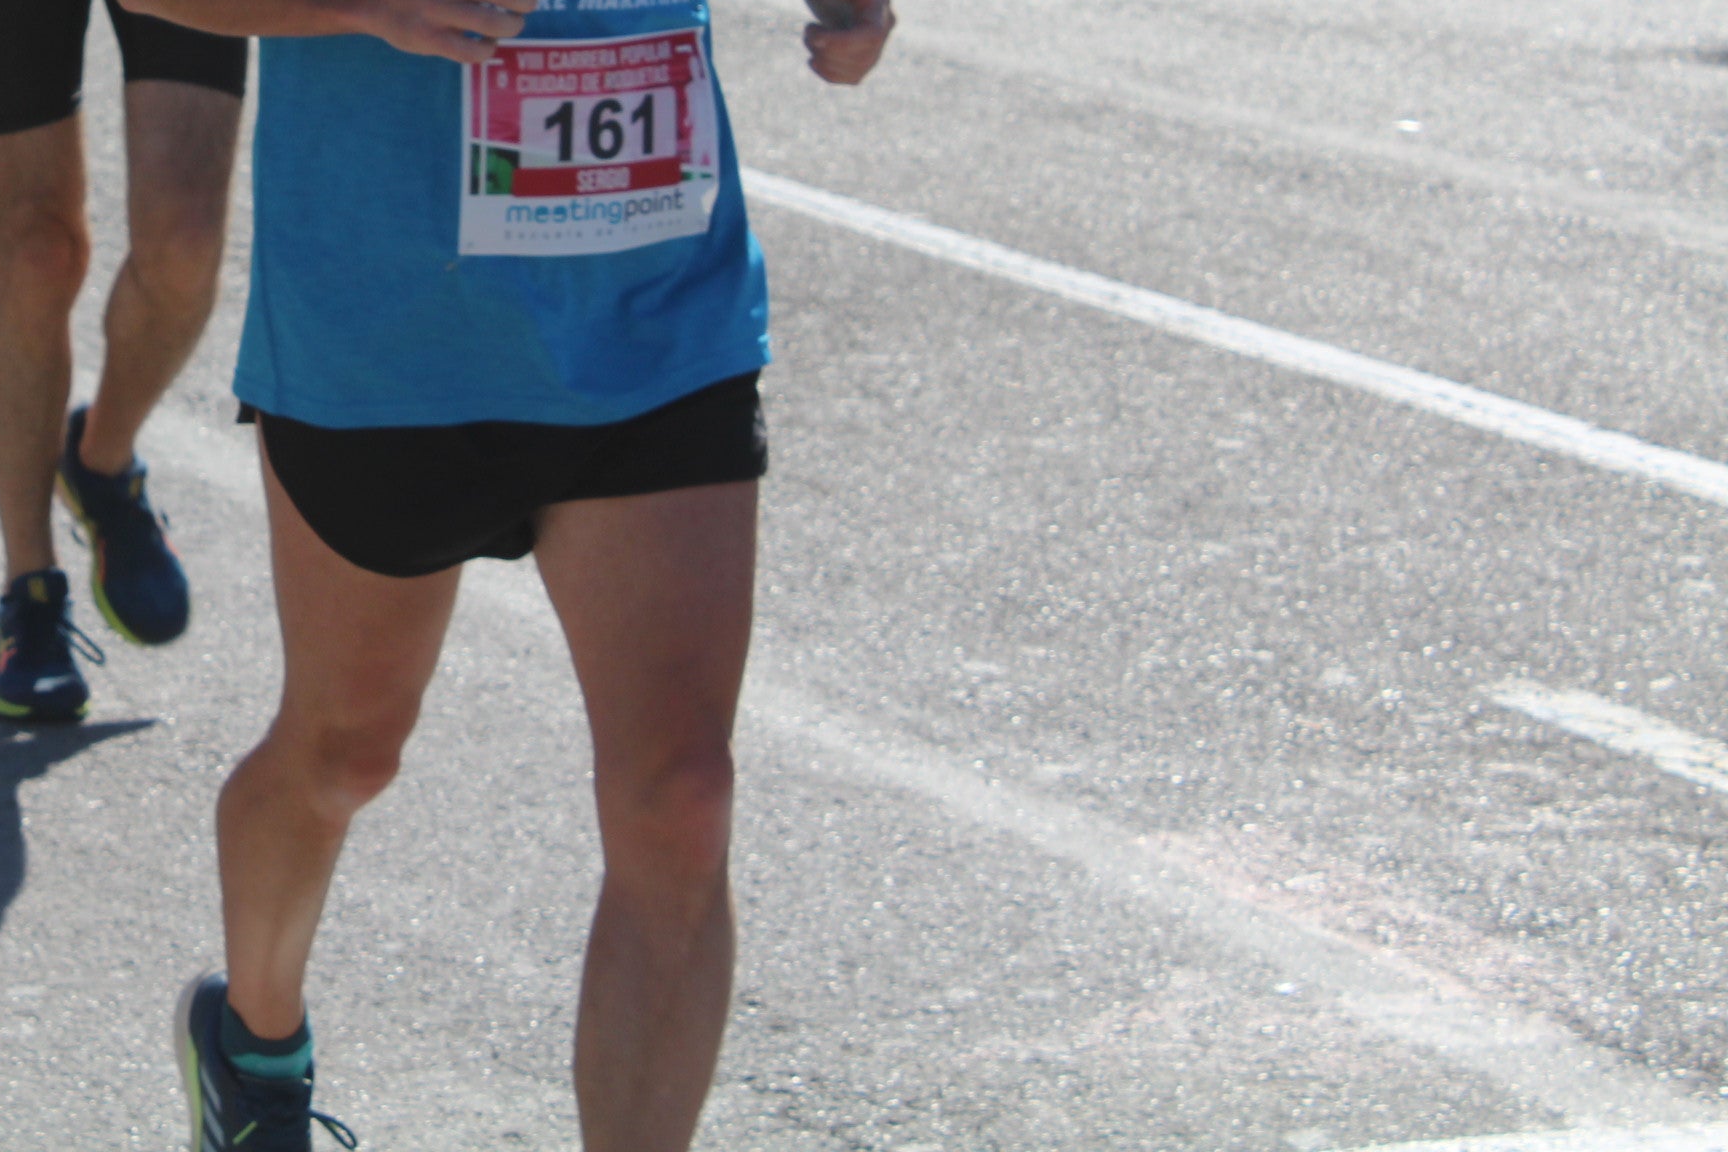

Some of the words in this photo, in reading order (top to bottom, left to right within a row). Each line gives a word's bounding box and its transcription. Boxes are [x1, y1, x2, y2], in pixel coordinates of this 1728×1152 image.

[547, 49, 617, 70] CARRERA
[544, 93, 654, 163] 161
[576, 166, 631, 193] SERGIO
[505, 188, 685, 224] meetingpoint
